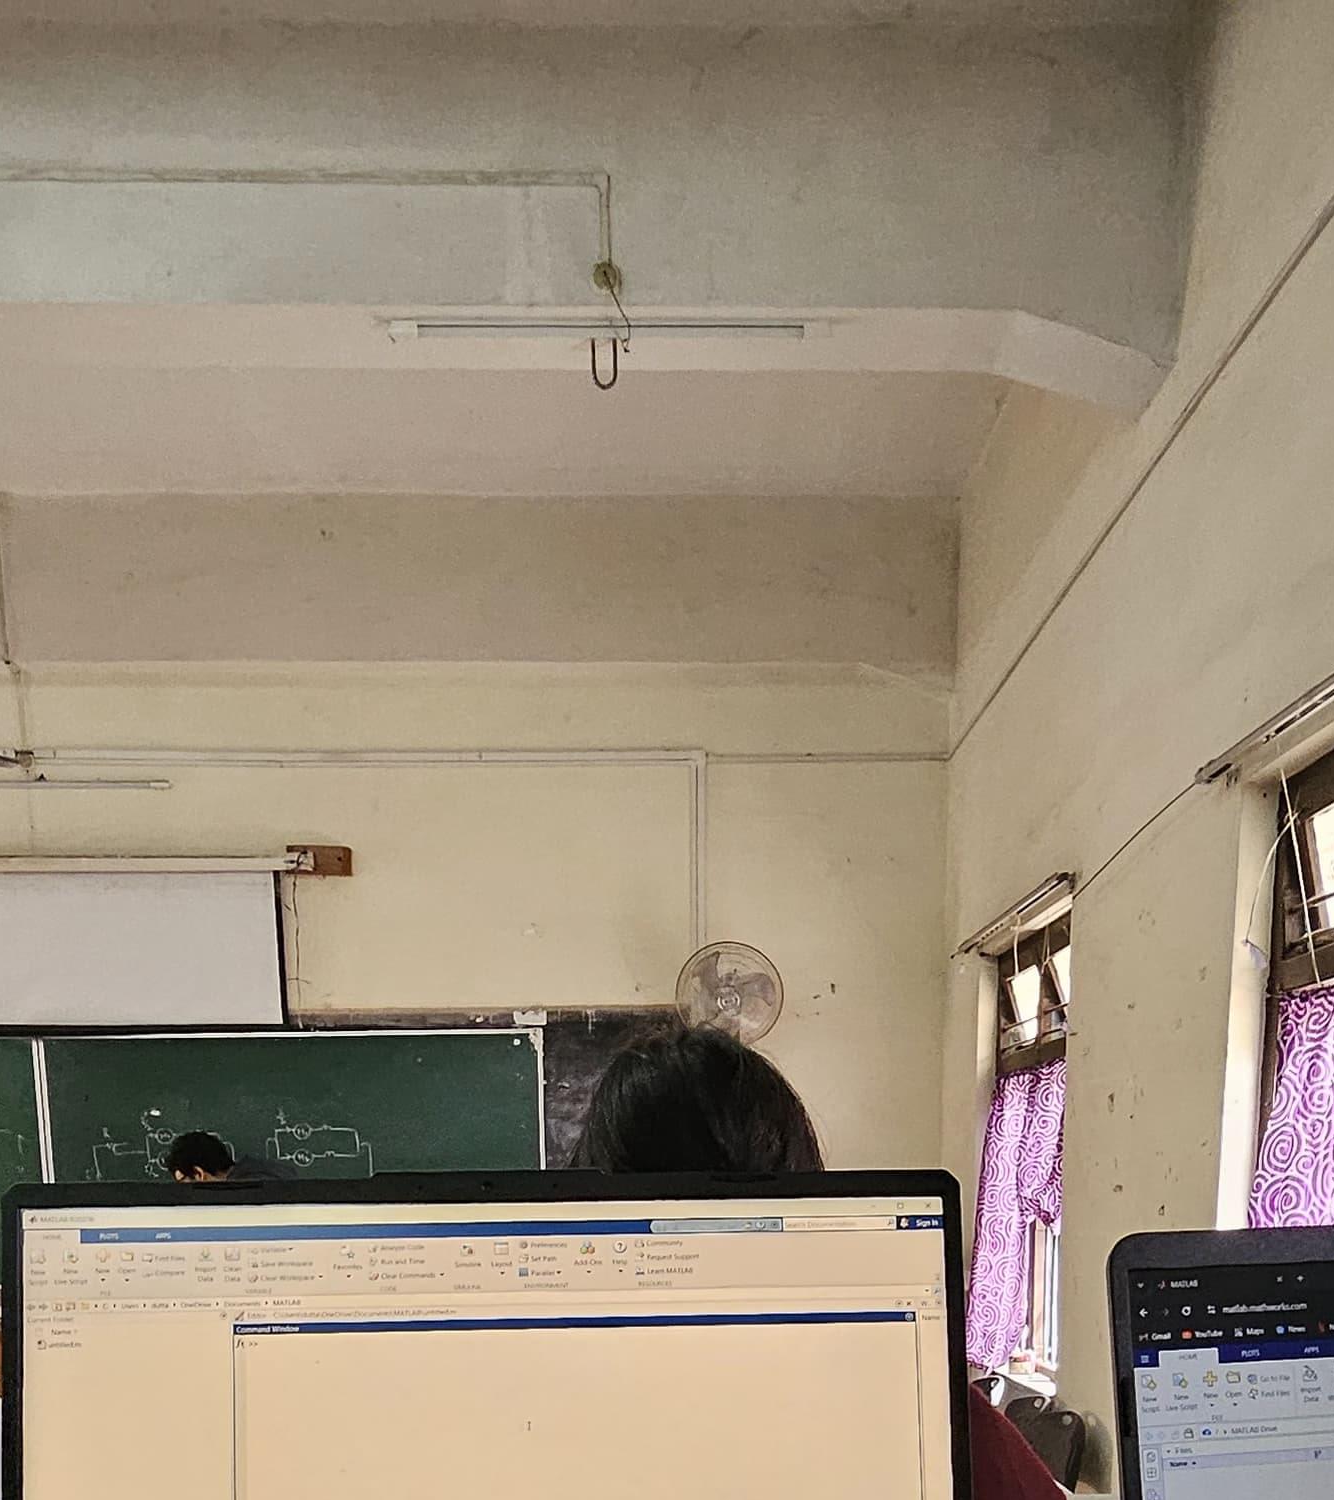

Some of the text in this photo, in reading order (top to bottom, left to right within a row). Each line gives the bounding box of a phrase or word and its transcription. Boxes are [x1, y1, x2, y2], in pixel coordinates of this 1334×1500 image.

[666, 1267, 694, 1275] MATLAB
[1170, 1279, 1199, 1289] MATLAB
[1222, 1302, 1308, 1314] matlab.mathworks.com
[235, 1325, 300, 1334] Command Window
[1151, 1331, 1172, 1341] Gmail
[1194, 1329, 1224, 1339] YouTube
[1246, 1327, 1265, 1337] Maps
[1287, 1324, 1307, 1333] News
[1241, 1349, 1261, 1358] PLOTS
